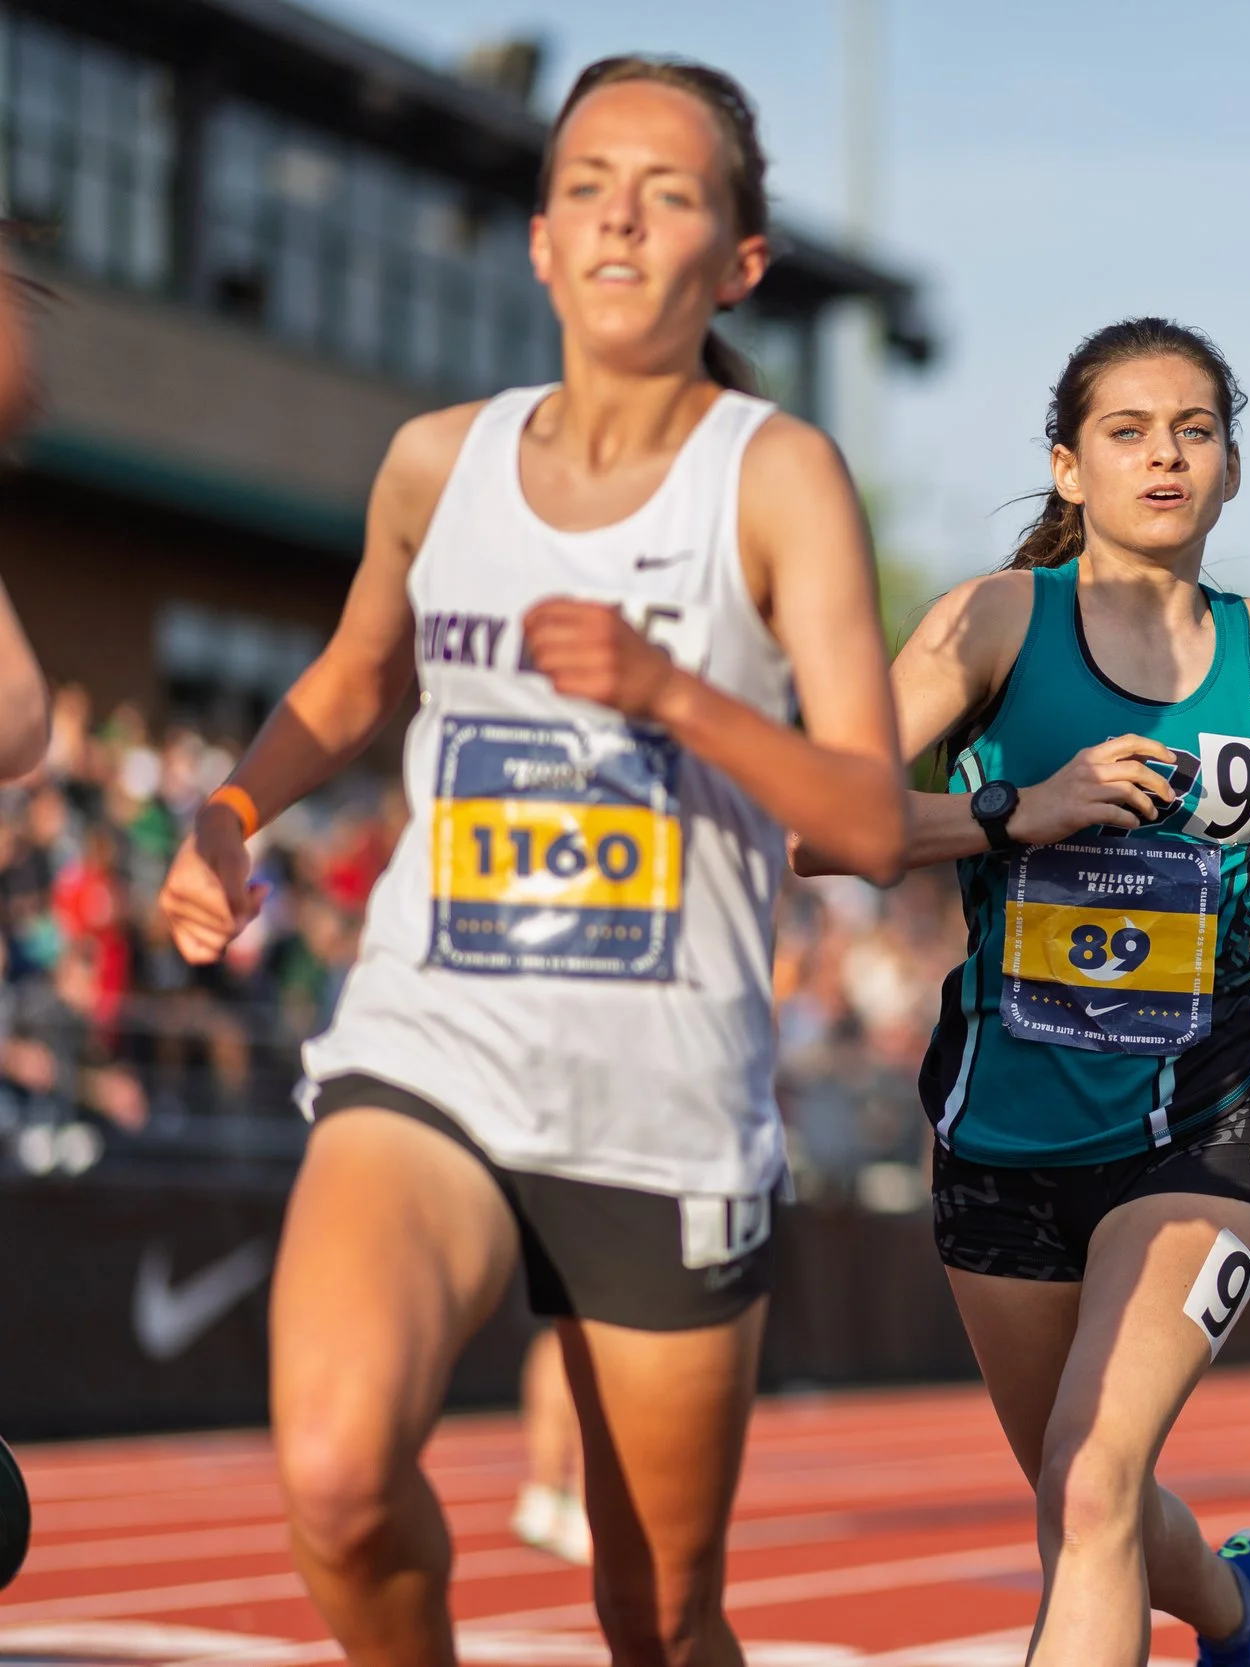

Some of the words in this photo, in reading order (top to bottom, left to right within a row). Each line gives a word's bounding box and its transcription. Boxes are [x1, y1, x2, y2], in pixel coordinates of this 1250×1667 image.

[473, 826, 640, 882] 1160
[1054, 844, 1101, 854] CELEBRATING
[1116, 848, 1137, 856] YEARS
[1146, 850, 1163, 858] ELITE
[1165, 851, 1186, 860] TRACK
[1188, 853, 1194, 861] &
[1195, 857, 1208, 877] FIELD
[1018, 864, 1028, 887] TRACK
[1078, 871, 1155, 885] TWILIGHT
[1087, 882, 1144, 895] RELAYS
[1017, 889, 1025, 908] ELITE
[1198, 887, 1208, 933] CELEBRATING
[1068, 924, 1151, 972] 89
[1197, 936, 1204, 946] 25
[1193, 978, 1201, 996] ELITE
[1010, 1002, 1023, 1023] FIELD
[1191, 998, 1199, 1021] TRACK
[1031, 1022, 1054, 1032] TRACK
[1056, 1025, 1074, 1036] ELITE
[1084, 1031, 1106, 1040] YEARS
[1120, 1035, 1165, 1044] CELEBRATING
[1176, 1030, 1195, 1045] FIELD
[1201, 1251, 1250, 1338] 9
